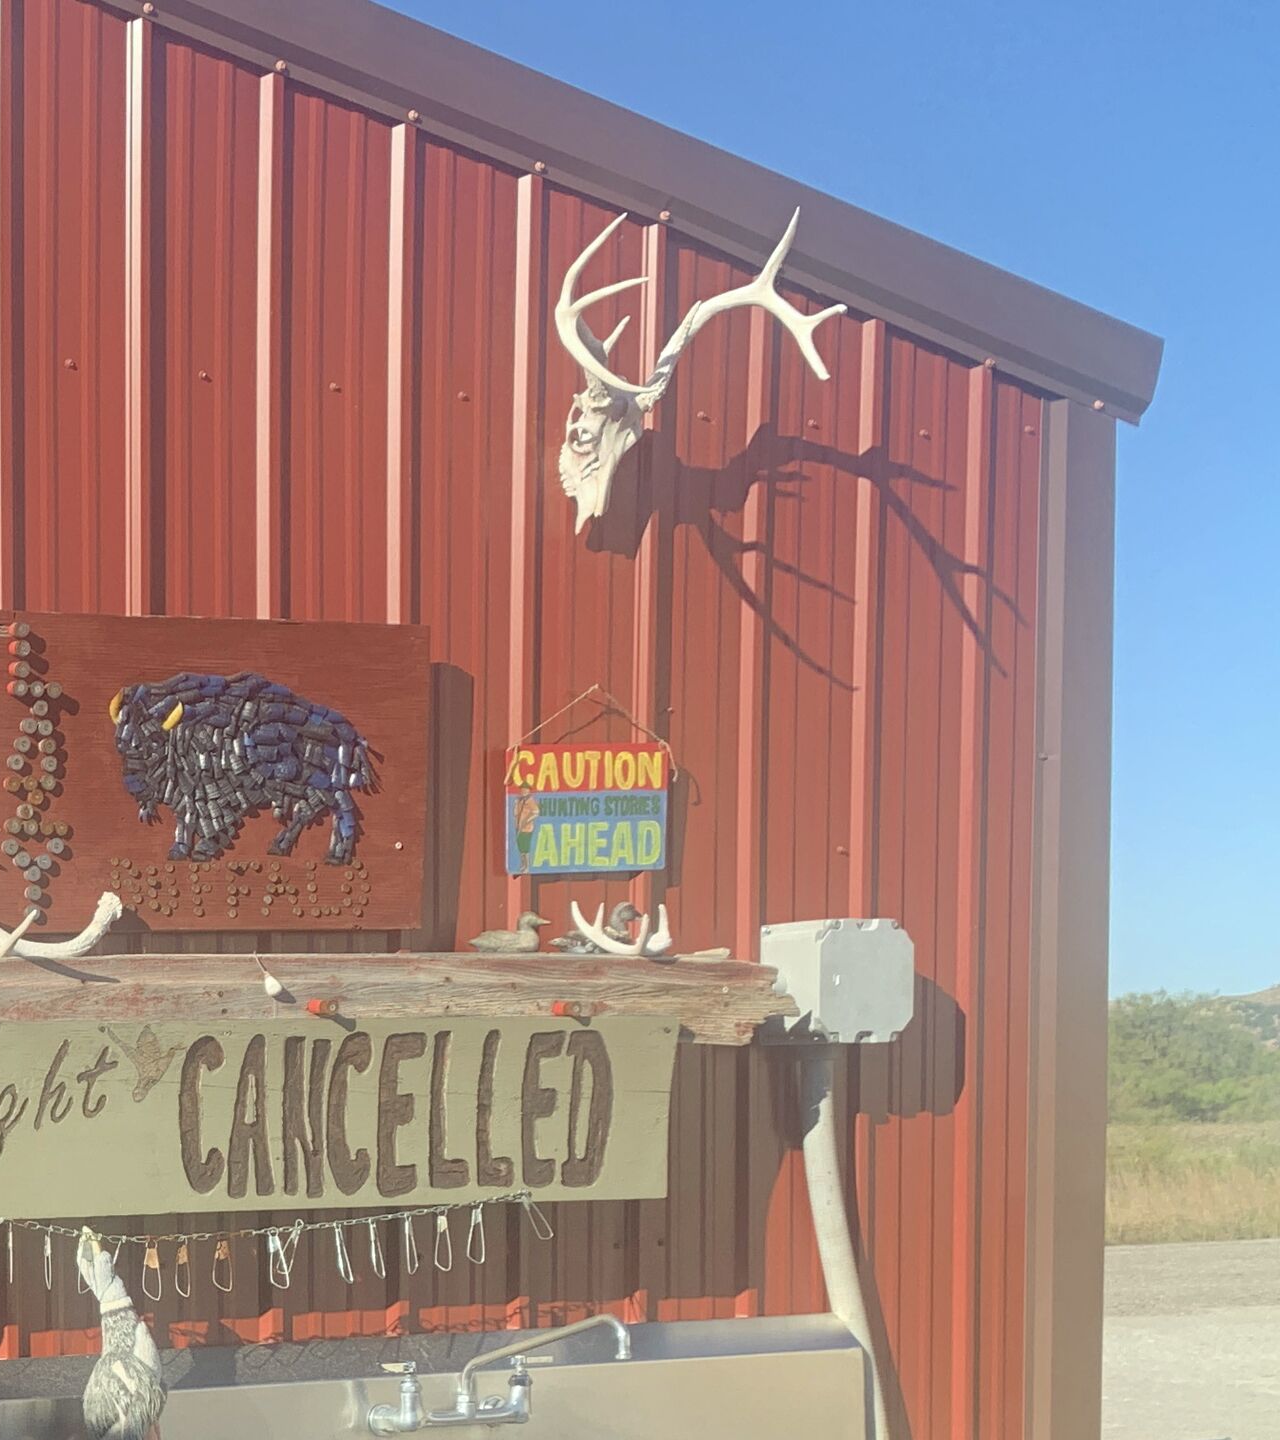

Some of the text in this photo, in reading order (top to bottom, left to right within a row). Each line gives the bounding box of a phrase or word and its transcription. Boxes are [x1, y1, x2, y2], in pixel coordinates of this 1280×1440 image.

[512, 750, 663, 791] CAUTION
[539, 796, 601, 817] HUNTING
[532, 820, 662, 867] AHEAD
[177, 1027, 614, 1199] CANCELLED
